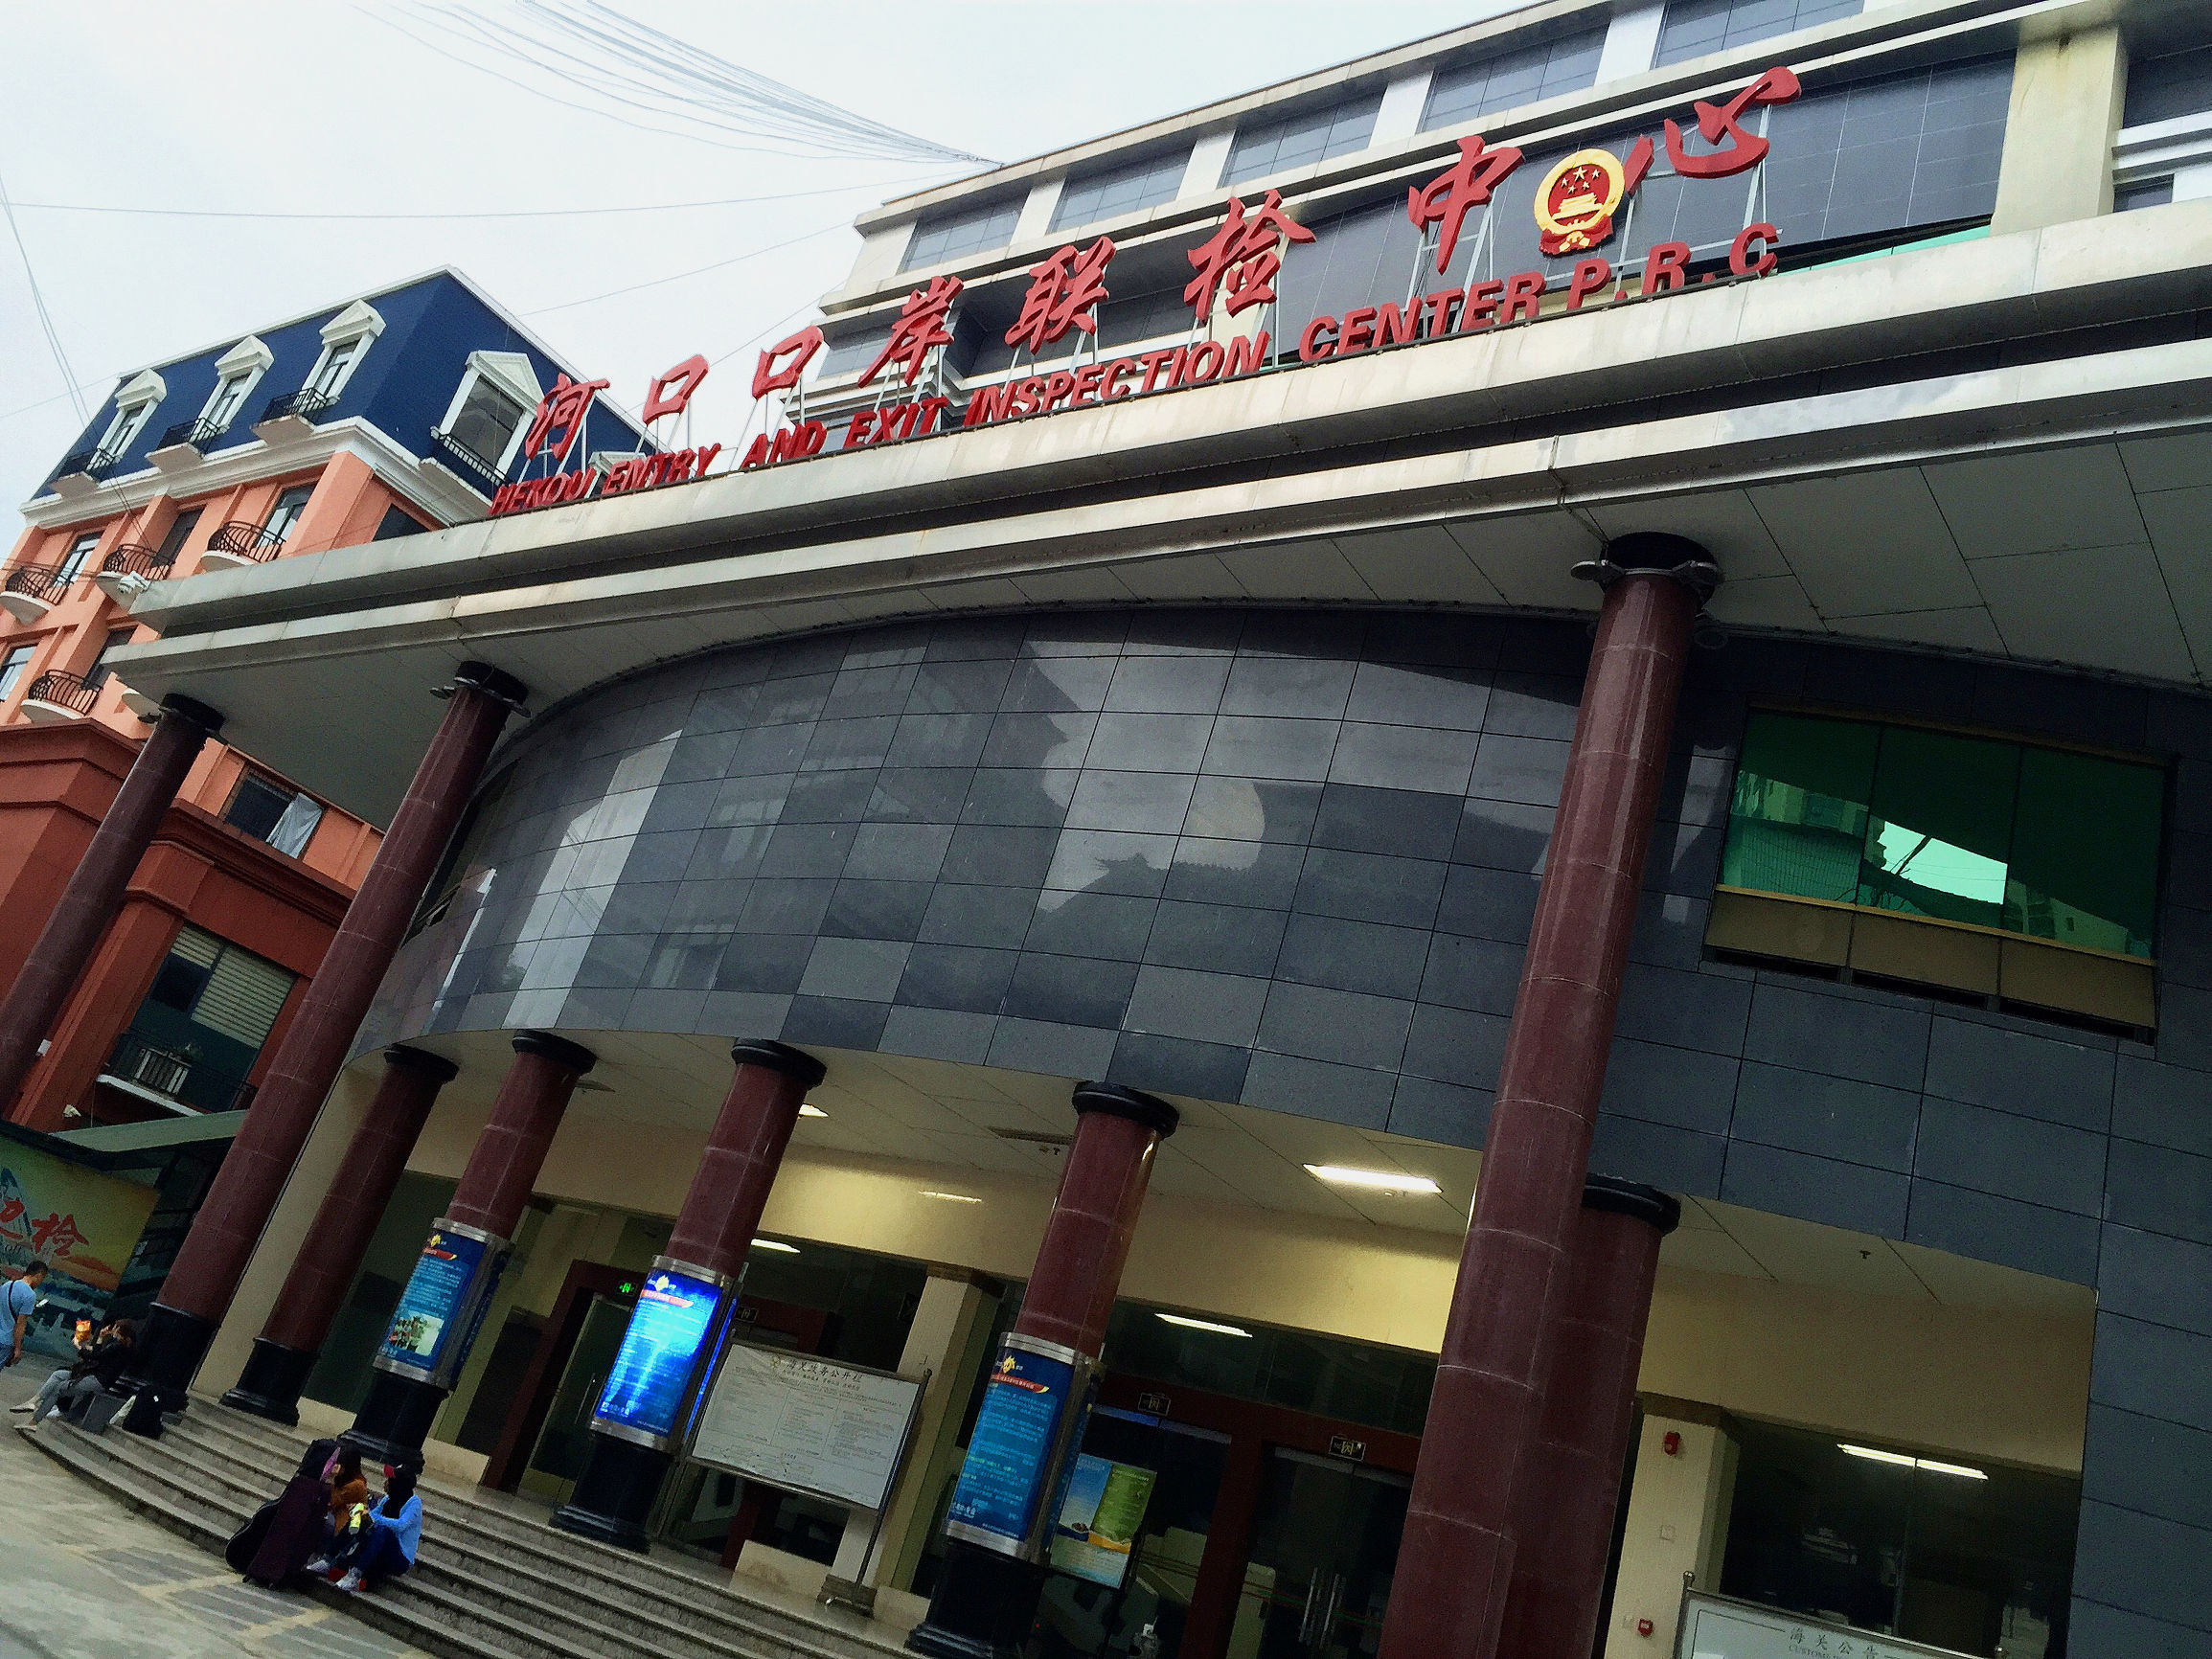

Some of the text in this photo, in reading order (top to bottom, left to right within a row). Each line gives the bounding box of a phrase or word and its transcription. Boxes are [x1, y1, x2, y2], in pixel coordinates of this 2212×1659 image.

[488, 468, 596, 516] HEKOU
[602, 443, 721, 495] ENTRY
[740, 420, 828, 469] AND
[844, 397, 948, 450] EXIT
[963, 330, 1270, 427] INSPECTION
[1298, 272, 1546, 362] CENTER
[524, 66, 1801, 462] 河口口岸联检中心
